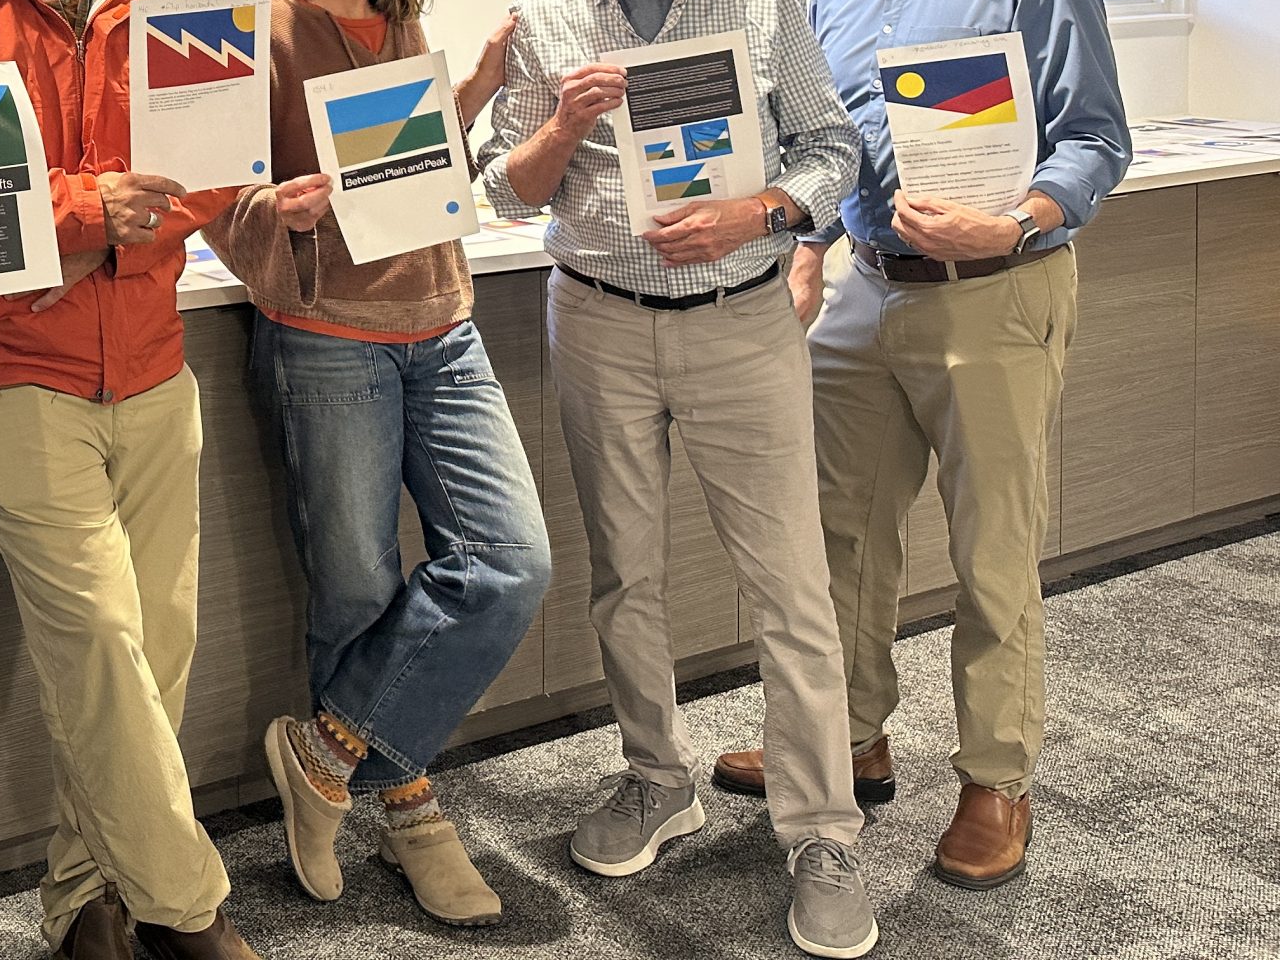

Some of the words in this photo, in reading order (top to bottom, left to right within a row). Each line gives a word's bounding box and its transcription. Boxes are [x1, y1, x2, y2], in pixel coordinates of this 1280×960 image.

[345, 172, 384, 187] Between
[385, 167, 407, 177] Plain
[407, 162, 424, 172] and
[424, 157, 448, 168] Peak
